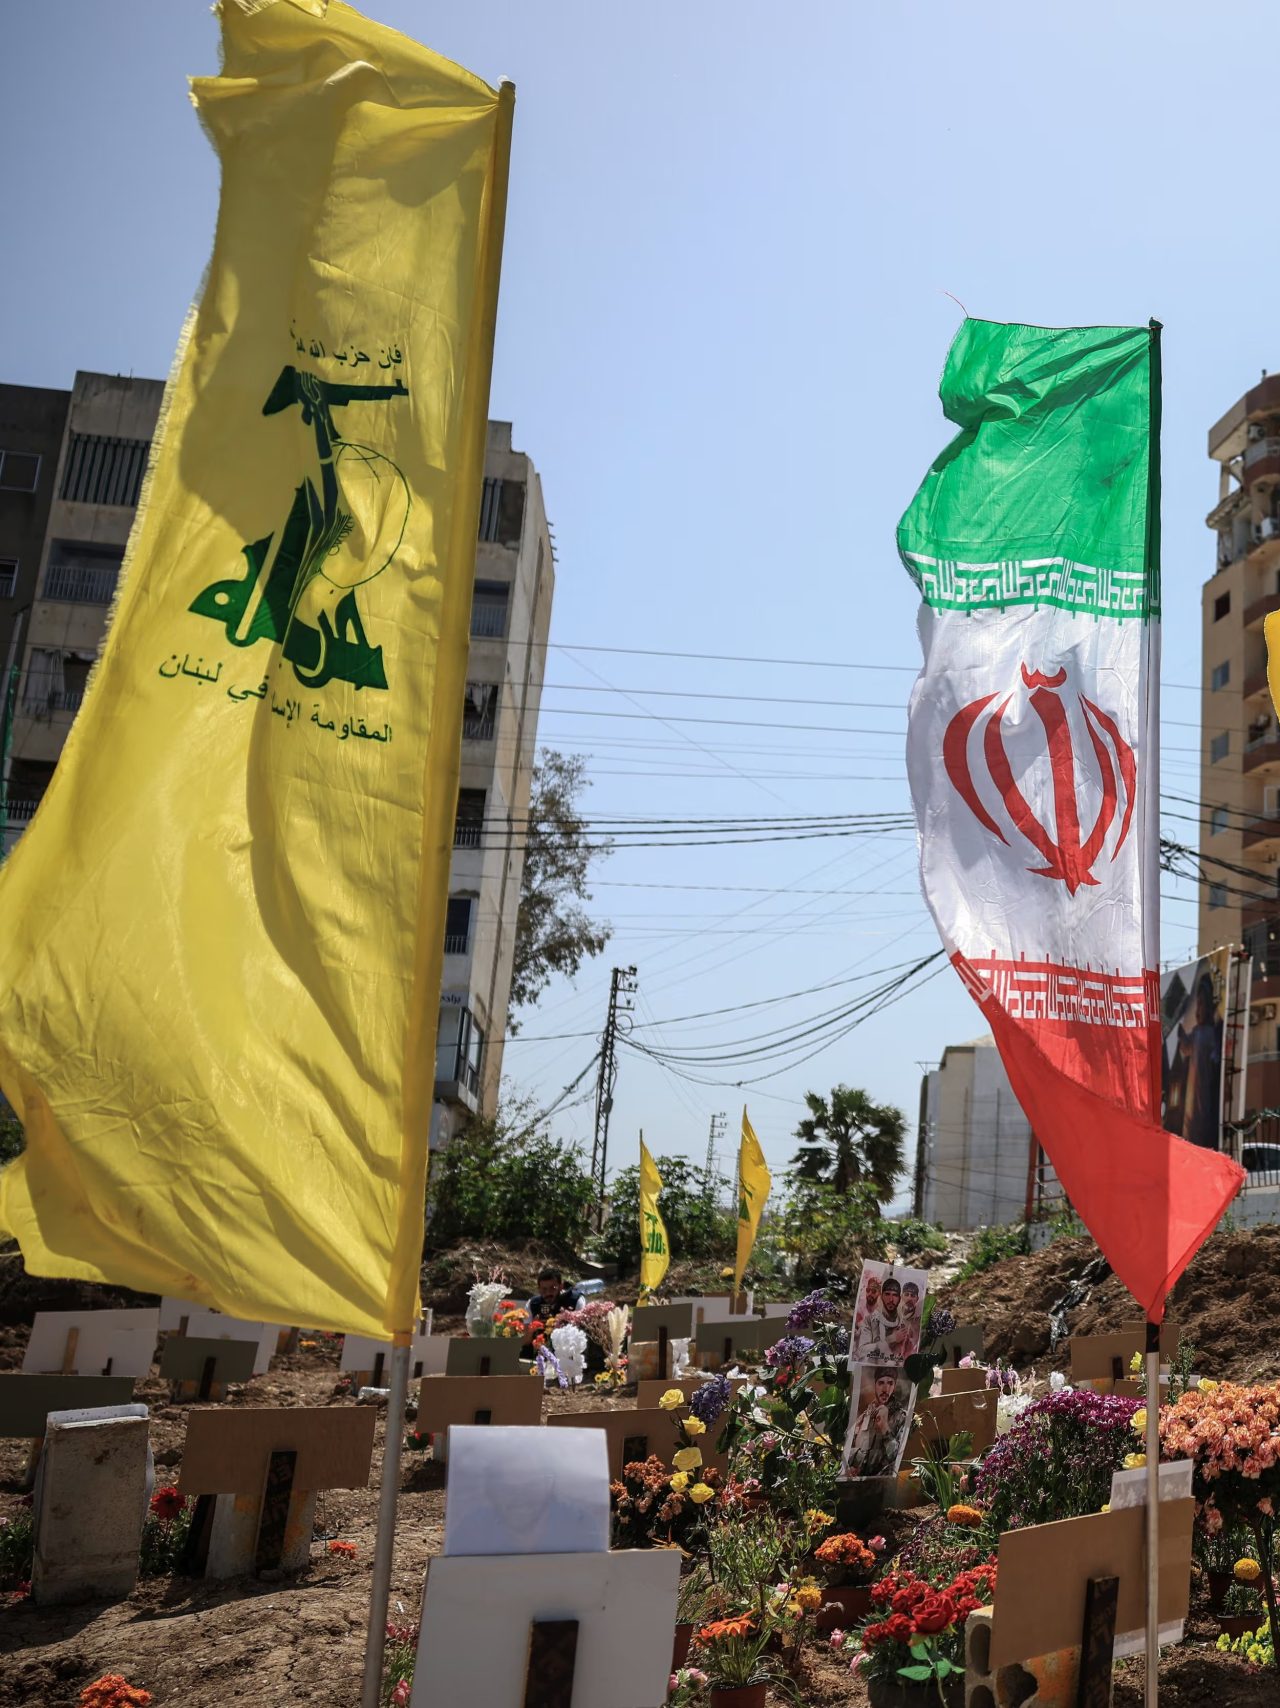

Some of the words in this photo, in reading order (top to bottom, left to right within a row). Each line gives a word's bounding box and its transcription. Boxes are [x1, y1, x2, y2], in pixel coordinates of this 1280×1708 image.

[332, 345, 371, 368] حزب
[378, 344, 402, 370] فإن
[158, 653, 224, 686] لبنان
[226, 674, 271, 704] في
[310, 703, 393, 743] المقاومة
